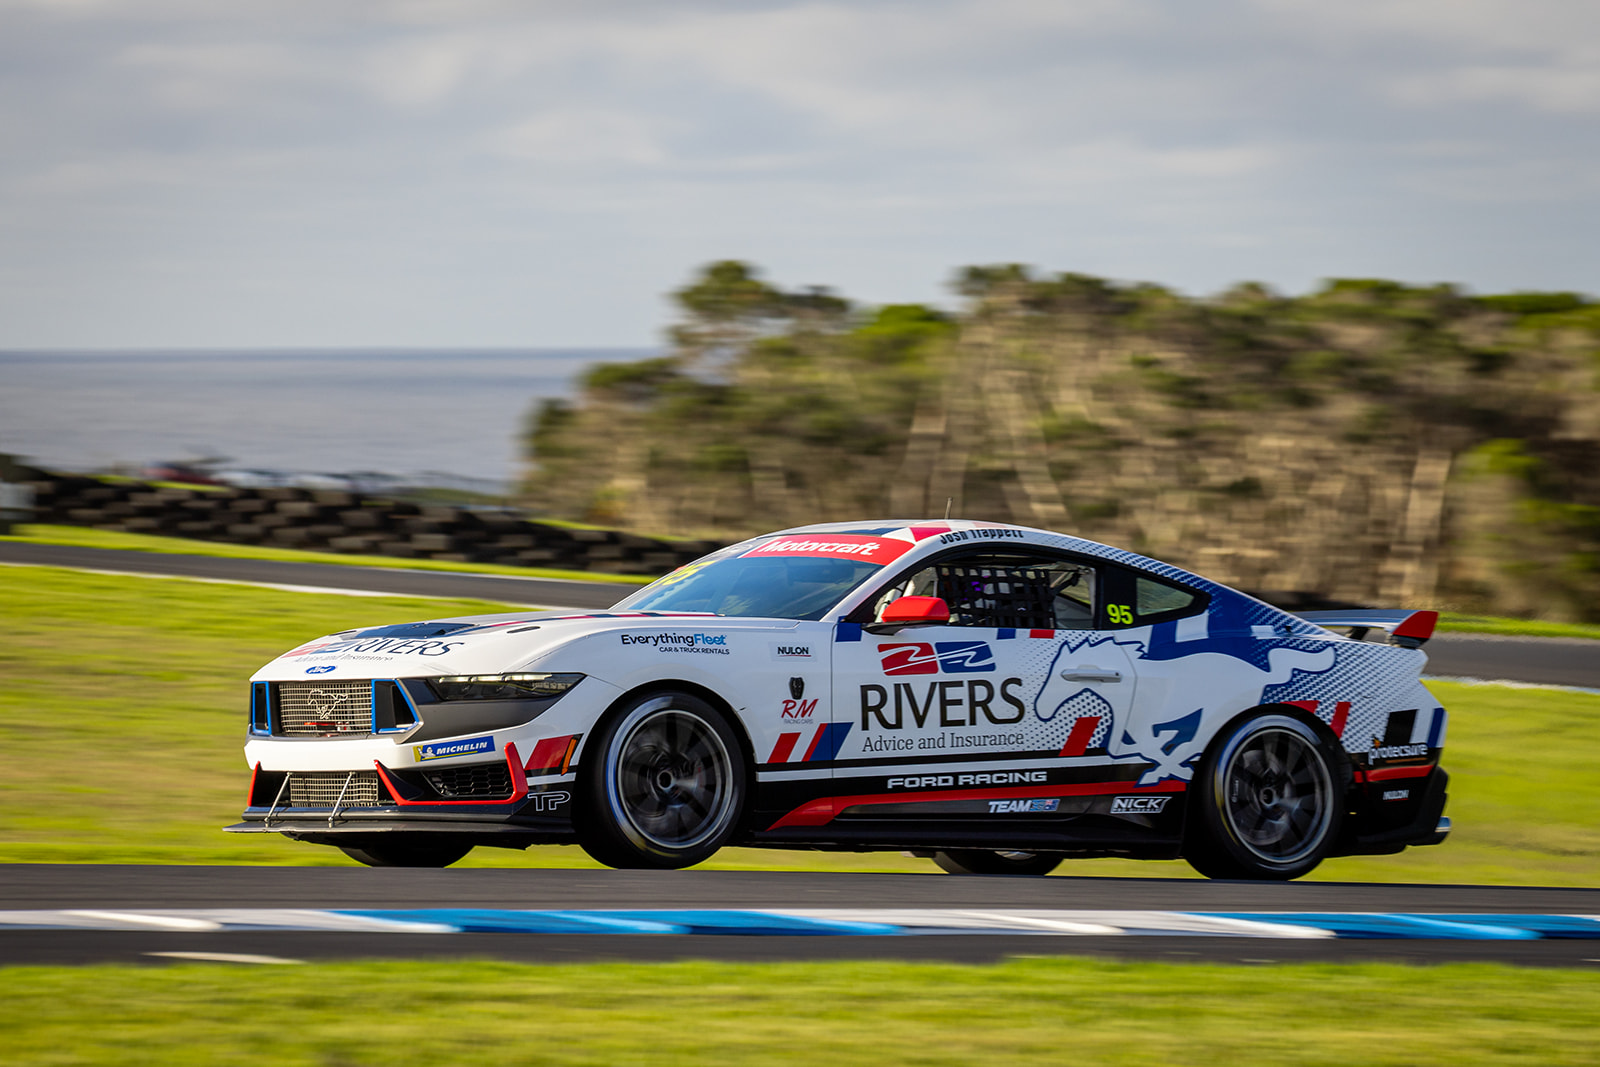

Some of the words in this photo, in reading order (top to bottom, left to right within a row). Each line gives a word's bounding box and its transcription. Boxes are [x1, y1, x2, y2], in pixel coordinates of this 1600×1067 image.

[758, 540, 880, 556] Motorcraft
[1106, 603, 1134, 625] 95
[621, 632, 726, 646] EverythingFleet
[344, 639, 465, 656] RIVERS
[701, 647, 730, 655] RENTALS
[777, 646, 809, 655] NULON
[781, 698, 819, 719] RM
[860, 677, 1026, 731] RIVERS
[436, 741, 488, 755] MICHELIN
[862, 735, 914, 752] Advice
[918, 732, 946, 749] and
[949, 732, 1025, 748] Insurance
[887, 776, 954, 789] FORD
[958, 771, 1047, 785] RACING
[988, 800, 1031, 813] TEAM
[1113, 798, 1160, 809] NICK
